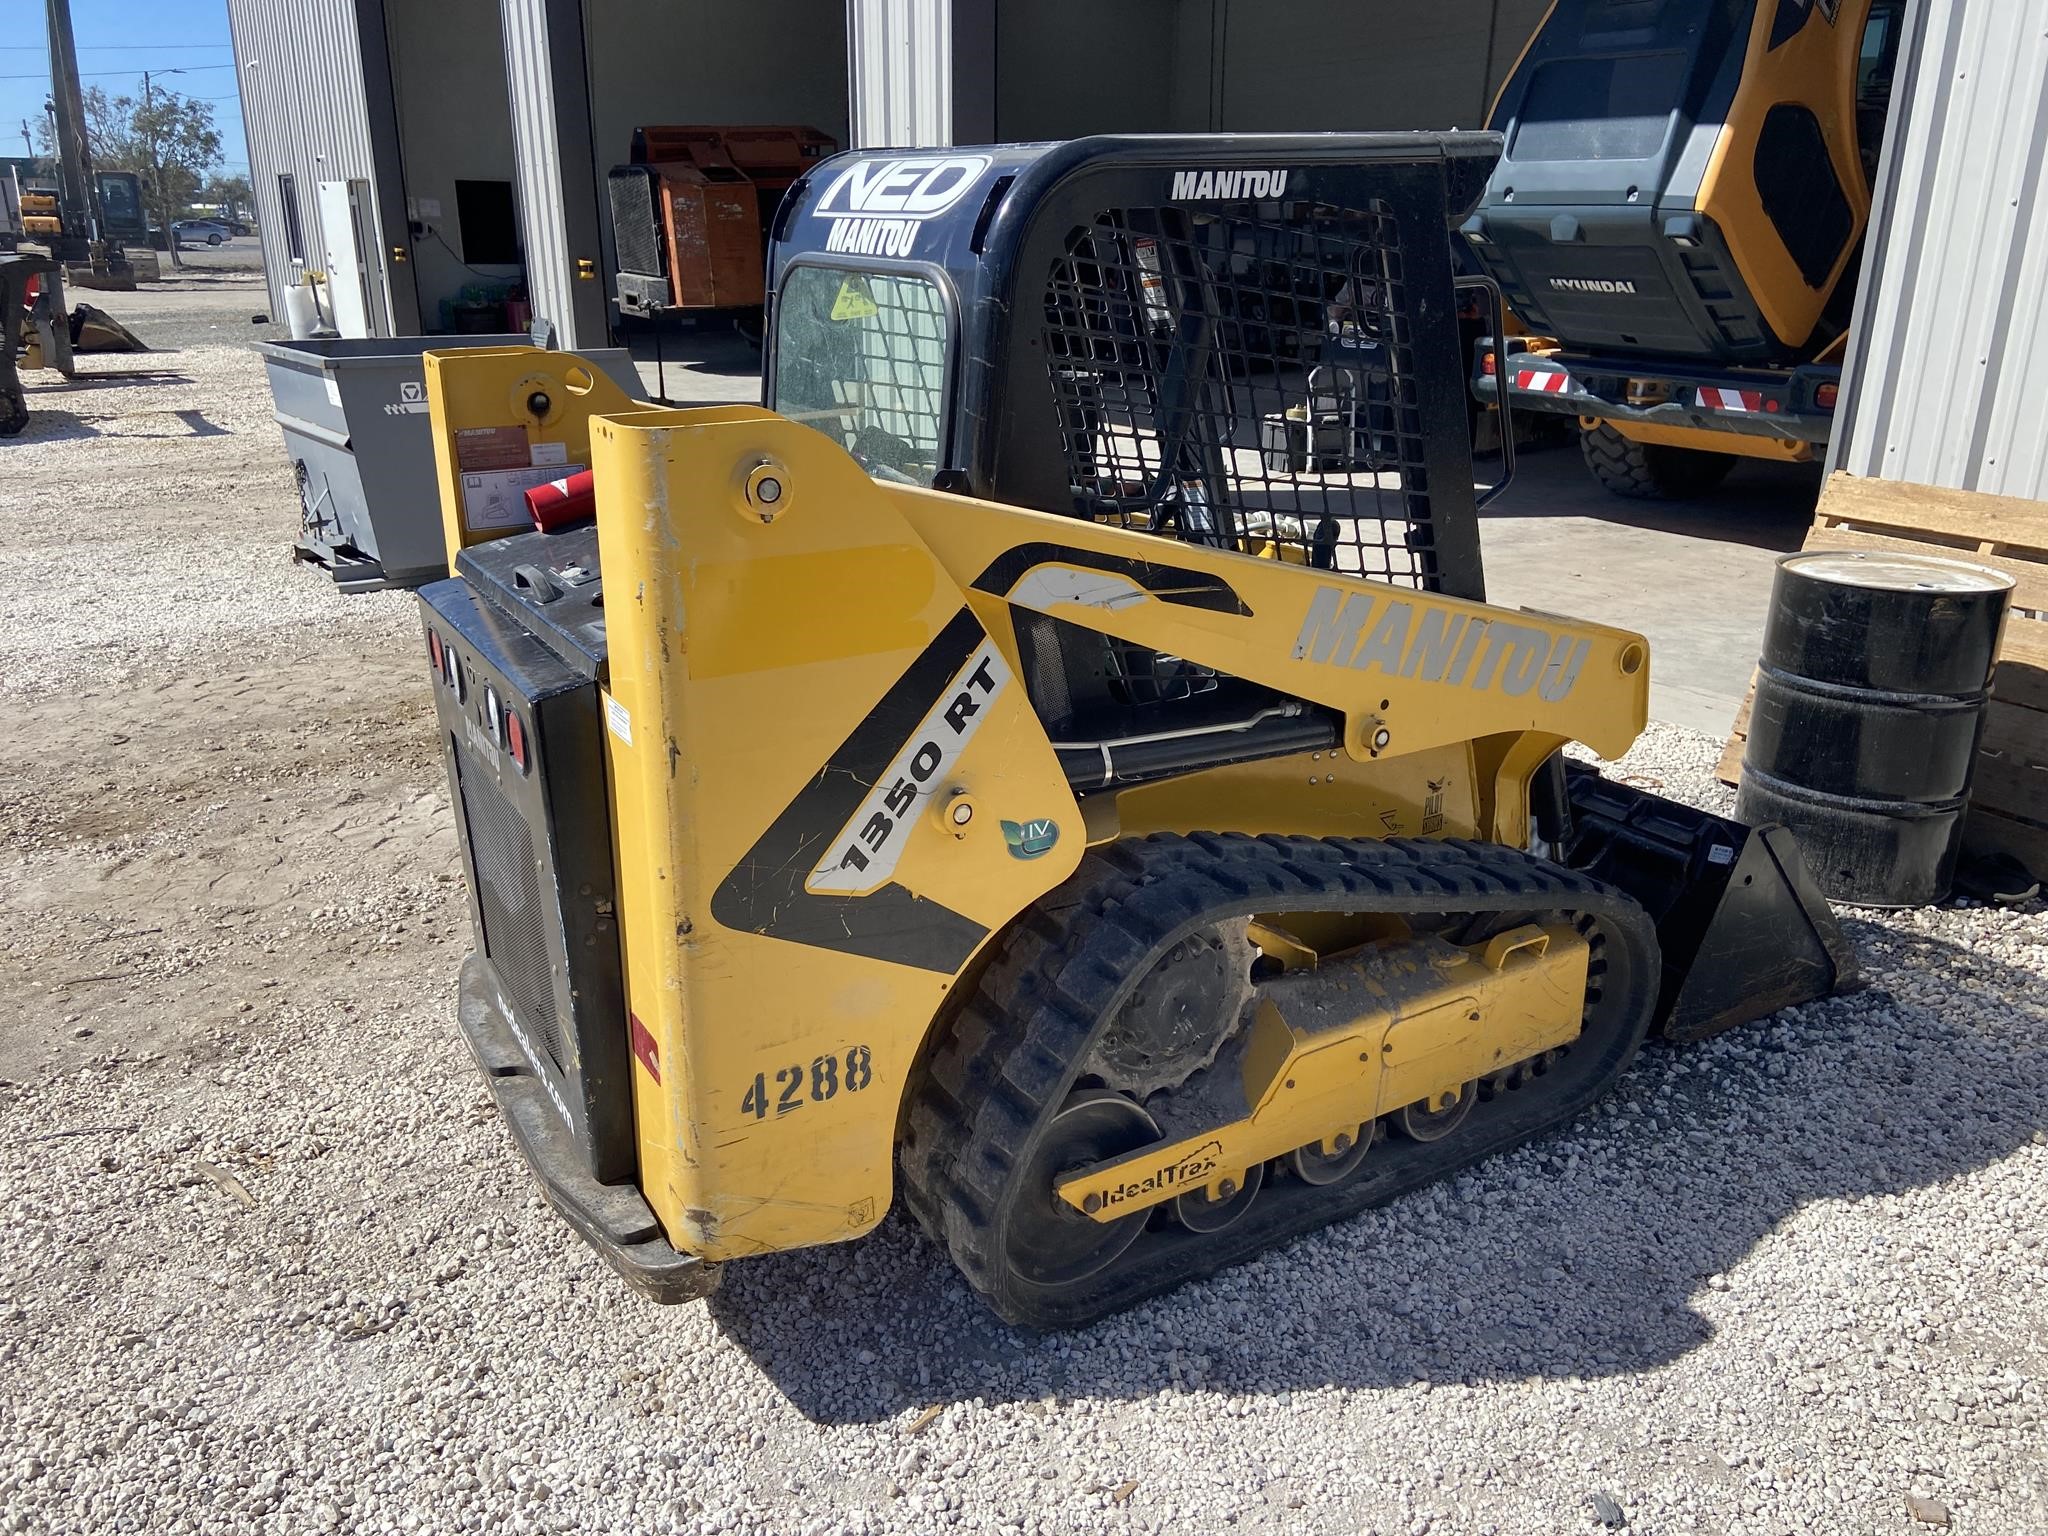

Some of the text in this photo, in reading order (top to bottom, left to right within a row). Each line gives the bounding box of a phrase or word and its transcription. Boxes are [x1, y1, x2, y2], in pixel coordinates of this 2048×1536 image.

[1171, 170, 1288, 201] MANITOU
[826, 218, 922, 258] MANITOU
[1549, 278, 1636, 294] HYUNDAI
[1290, 585, 1593, 702] MANITOU
[839, 655, 996, 874] 1350 RT
[497, 991, 576, 1139] nedealers.com
[741, 1044, 872, 1120] 4288
